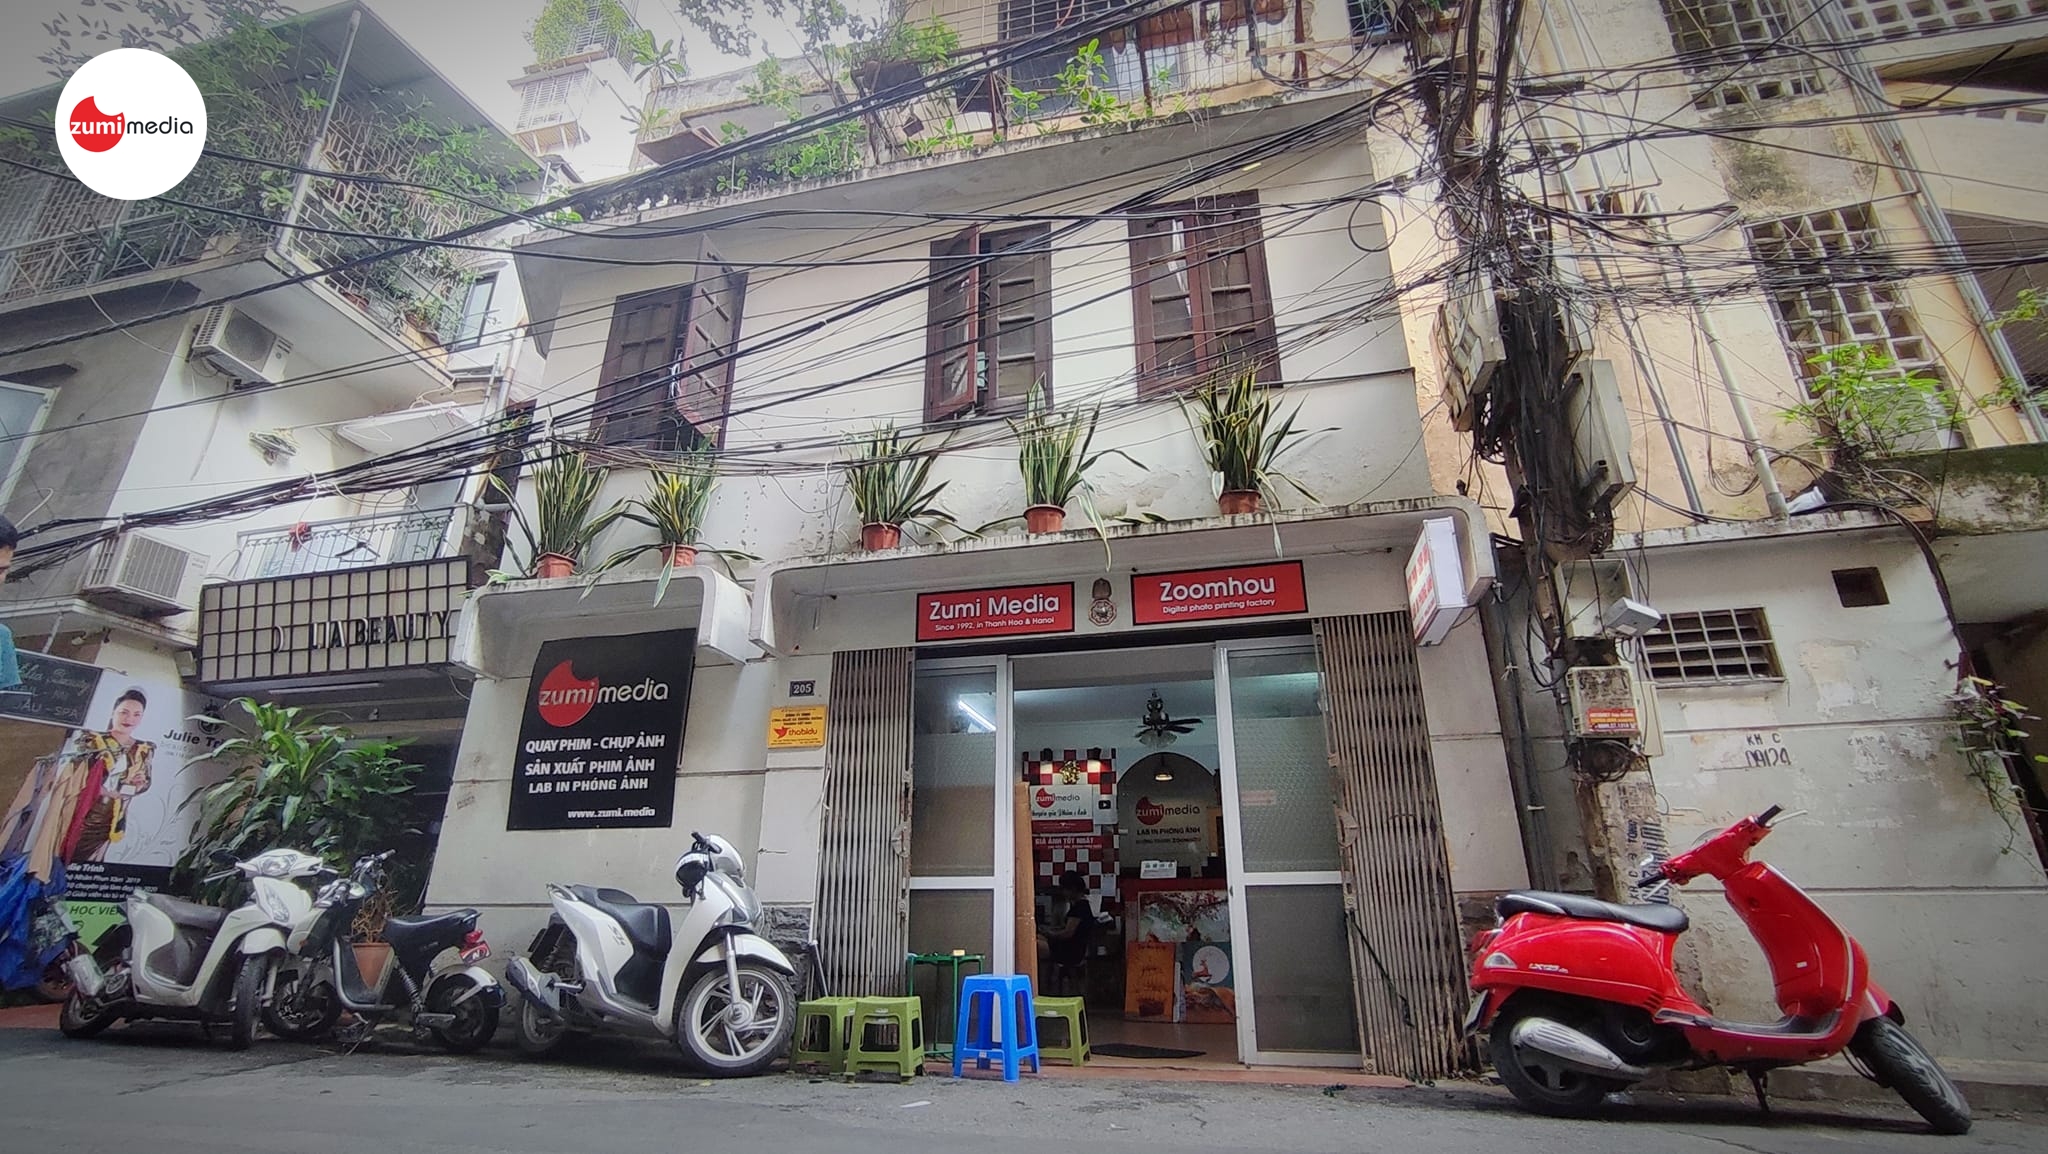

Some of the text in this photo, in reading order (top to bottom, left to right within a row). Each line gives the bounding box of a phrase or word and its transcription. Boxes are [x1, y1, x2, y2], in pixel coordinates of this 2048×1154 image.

[1159, 577, 1275, 601] Zoomhou
[929, 594, 1059, 620] Zumi Media
[1162, 599, 1275, 614] Digital photo printing factory
[354, 610, 451, 645] BEAUTY
[976, 621, 984, 629] in
[985, 620, 1007, 628] Thanh
[1032, 616, 1055, 624] Hanoi
[793, 683, 812, 694] 205
[53, 706, 79, 719] SPA
[163, 729, 201, 745] Julie
[525, 739, 559, 754] QUAY
[559, 738, 592, 751] PHIM
[600, 736, 636, 752] CHỤP
[636, 731, 666, 749] ẢNH
[525, 755, 655, 776] SẢN XUẤT PHIM ẢNH
[528, 781, 552, 794] LAB
[556, 780, 570, 792] IN
[620, 775, 649, 790] ẢNH
[567, 807, 656, 819] www.zumi.media
